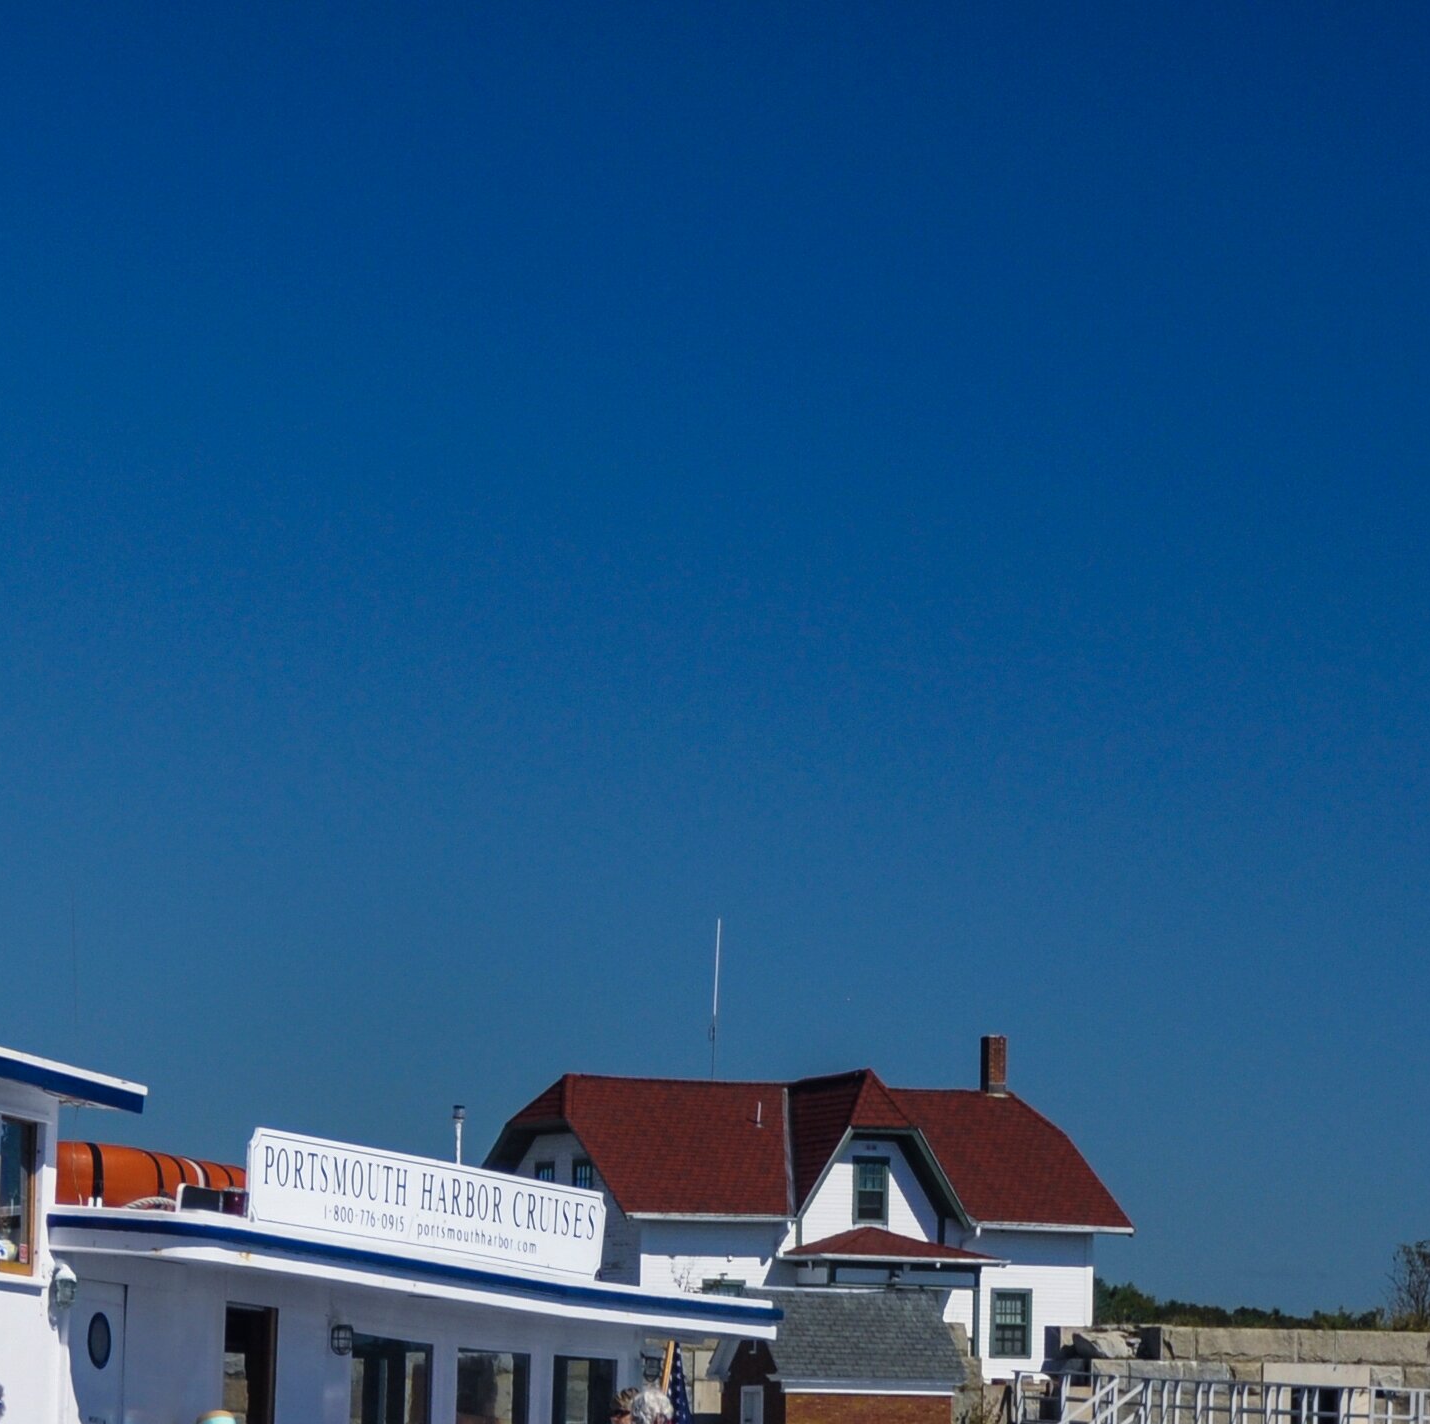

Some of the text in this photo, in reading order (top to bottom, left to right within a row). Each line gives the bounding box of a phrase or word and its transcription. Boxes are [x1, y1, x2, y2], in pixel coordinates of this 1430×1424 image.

[263, 1145, 596, 1241] PORTSMOUTH HARBOR CRUISES
[417, 1222, 537, 1254] portsmouthharbor.com
